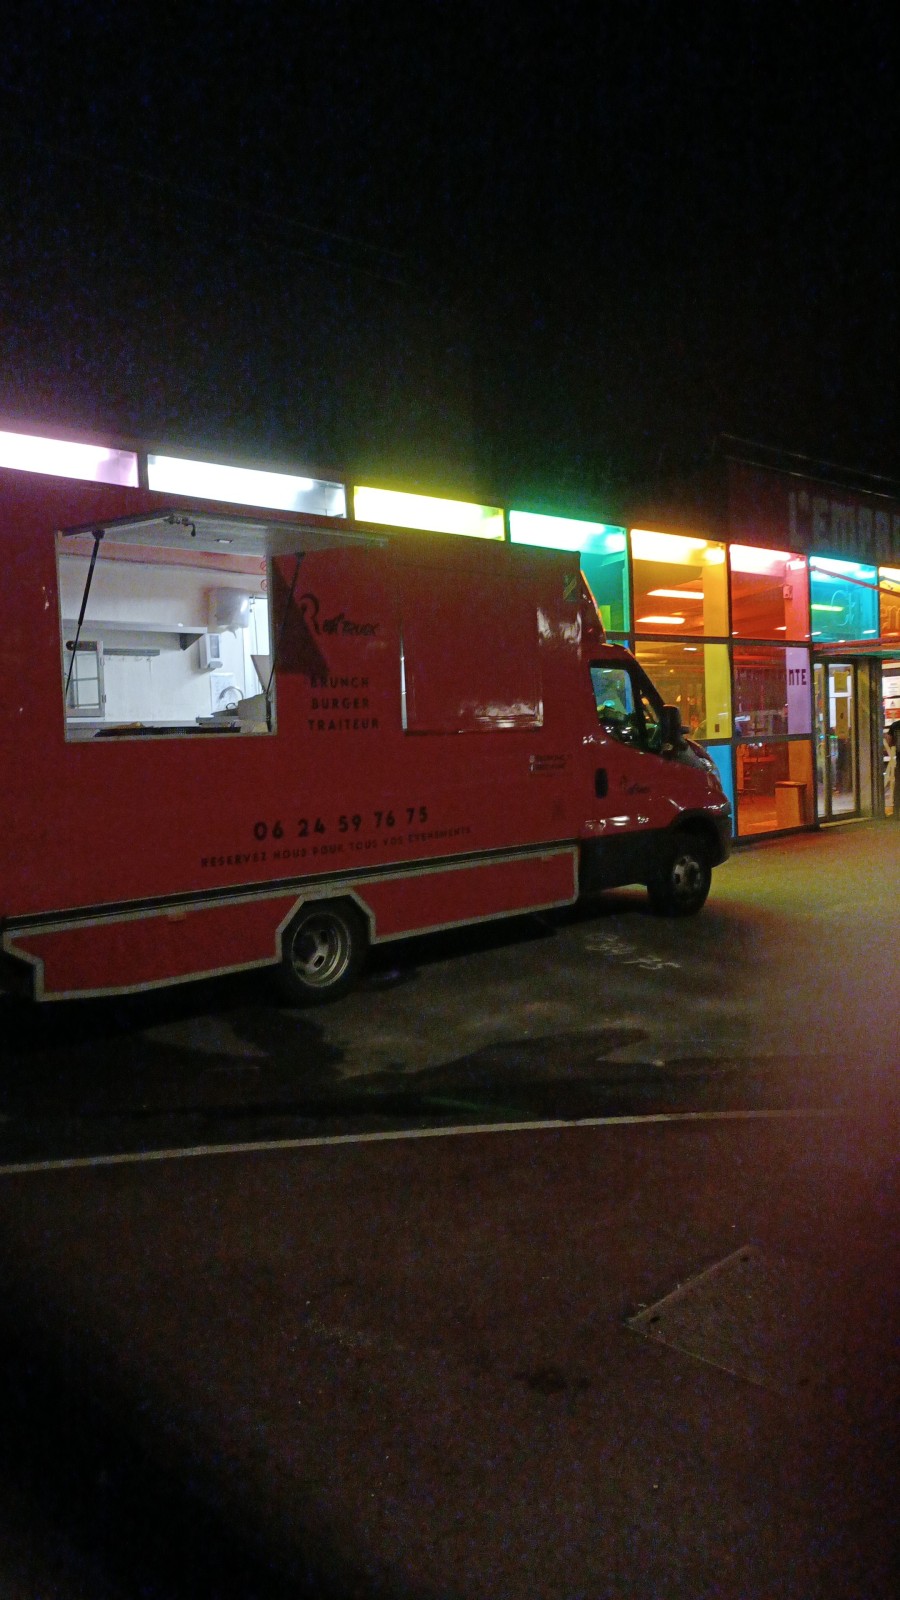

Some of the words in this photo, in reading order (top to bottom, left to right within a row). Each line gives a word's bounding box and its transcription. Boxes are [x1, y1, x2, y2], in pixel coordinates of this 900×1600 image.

[310, 676, 369, 689] BRUNCH
[311, 697, 370, 710] BURGER
[307, 718, 379, 731] TRAITEUR
[253, 820, 284, 841] 06
[297, 817, 326, 838] 24
[338, 814, 363, 833] 59
[374, 809, 396, 828] 76
[406, 805, 428, 824] 75
[273, 847, 307, 859] NOUS
[312, 843, 344, 855] POUR
[349, 839, 378, 850] TOUS
